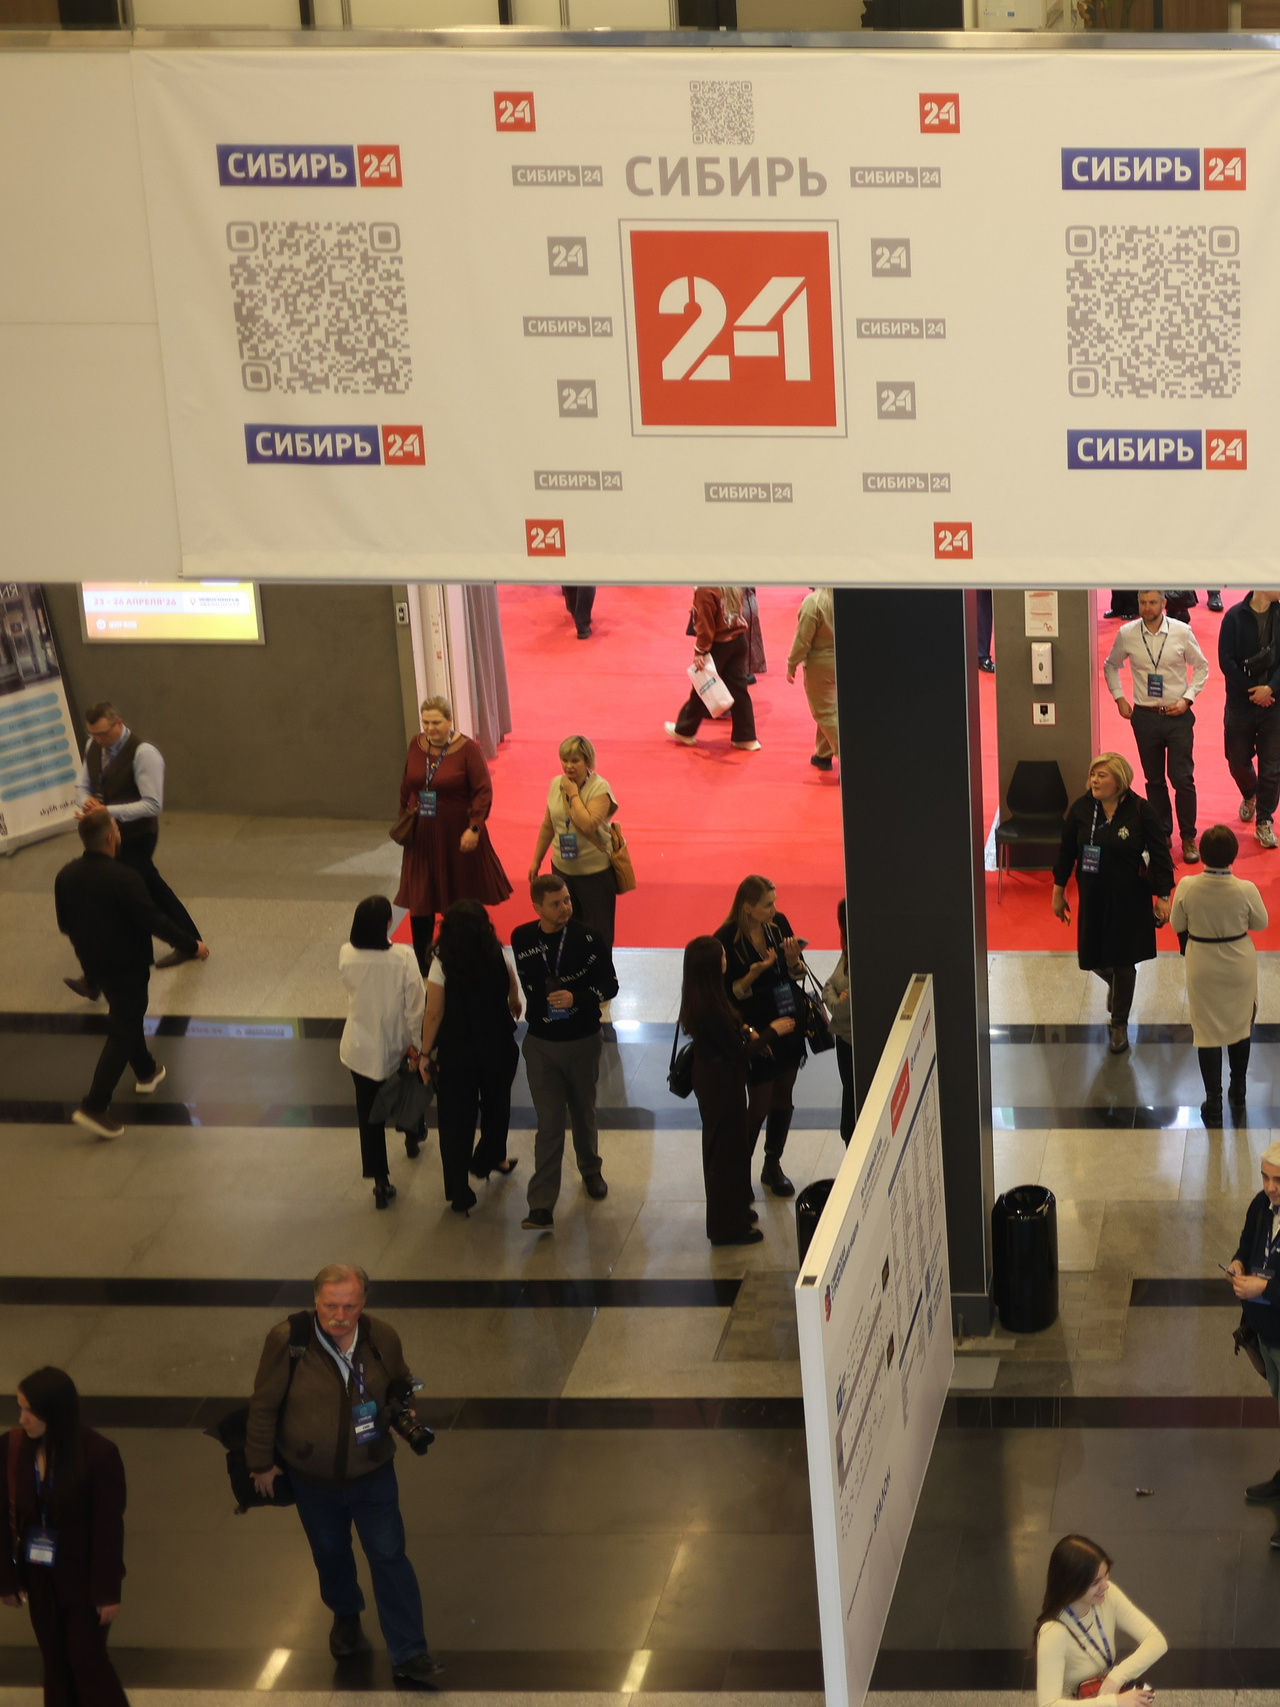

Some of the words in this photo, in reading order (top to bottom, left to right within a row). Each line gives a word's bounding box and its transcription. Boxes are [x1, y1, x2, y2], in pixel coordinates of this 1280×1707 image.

[499, 100, 531, 123] 24
[924, 101, 956, 125] 24
[227, 152, 348, 179] СИБИРЬ
[363, 153, 397, 178] 24
[517, 169, 577, 183] СИБИРЬ
[583, 169, 601, 183] 24
[625, 155, 828, 197] СИБИРЬ
[855, 170, 915, 184] СИБИРЬ
[922, 171, 939, 184] 24
[1071, 156, 1192, 182] СИБИРЬ
[1208, 157, 1242, 182] 24
[552, 245, 584, 268] 24
[875, 246, 907, 269] 24
[528, 320, 587, 333] СИБИРЬ
[594, 320, 611, 333] 24
[657, 275, 812, 382] 24
[861, 321, 920, 335] СИБИРЬ
[927, 322, 944, 335] 24
[562, 387, 594, 410] 24
[881, 389, 912, 412] 24
[255, 431, 372, 458] СИБИРЬ
[387, 433, 421, 457] 24
[1077, 437, 1194, 462] СИБИРЬ
[1210, 438, 1243, 462] 24
[539, 474, 597, 487] СИБИРЬ
[604, 475, 621, 487] 24
[867, 476, 925, 489] СИБИРЬ
[931, 476, 949, 490] 24
[709, 486, 768, 499] СИБИРЬ
[773, 486, 791, 499] 24
[530, 527, 561, 549] 24
[938, 529, 969, 551] 24
[518, 943, 549, 960] BALMAN
